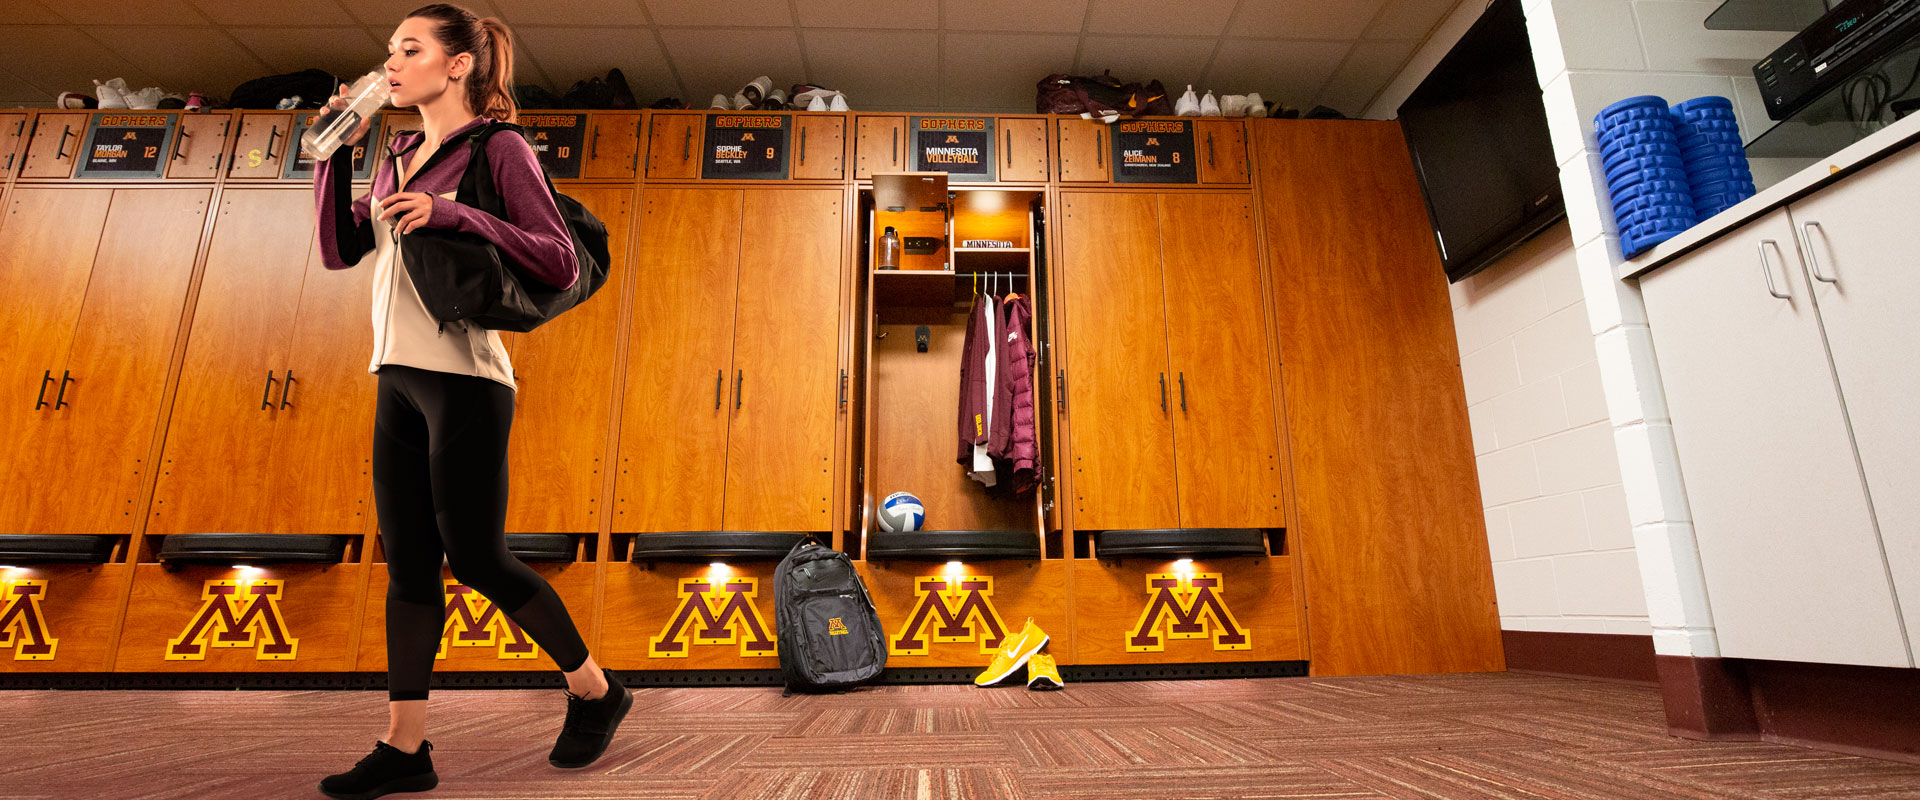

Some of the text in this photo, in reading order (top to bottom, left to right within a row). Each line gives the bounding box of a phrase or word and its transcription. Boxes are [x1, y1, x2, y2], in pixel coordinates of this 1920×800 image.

[100, 115, 167, 127] GOPHERS
[716, 116, 782, 128] GOPHERS
[920, 118, 985, 130] GOPHERS
[1121, 121, 1184, 133] GOPHERS
[144, 146, 157, 158] 12
[558, 146, 570, 158] 10
[715, 151, 748, 159] BECKLEY
[766, 147, 774, 159] 9
[926, 147, 979, 155] MINNESOTA
[248, 149, 261, 167] S
[926, 154, 979, 164] VOLLEYBALL
[1123, 155, 1157, 163] ZEIMANN
[1172, 152, 1180, 163] 8
[648, 577, 778, 658] M
[889, 575, 1020, 655] M
[1125, 573, 1252, 653] M
[165, 580, 299, 660] M
